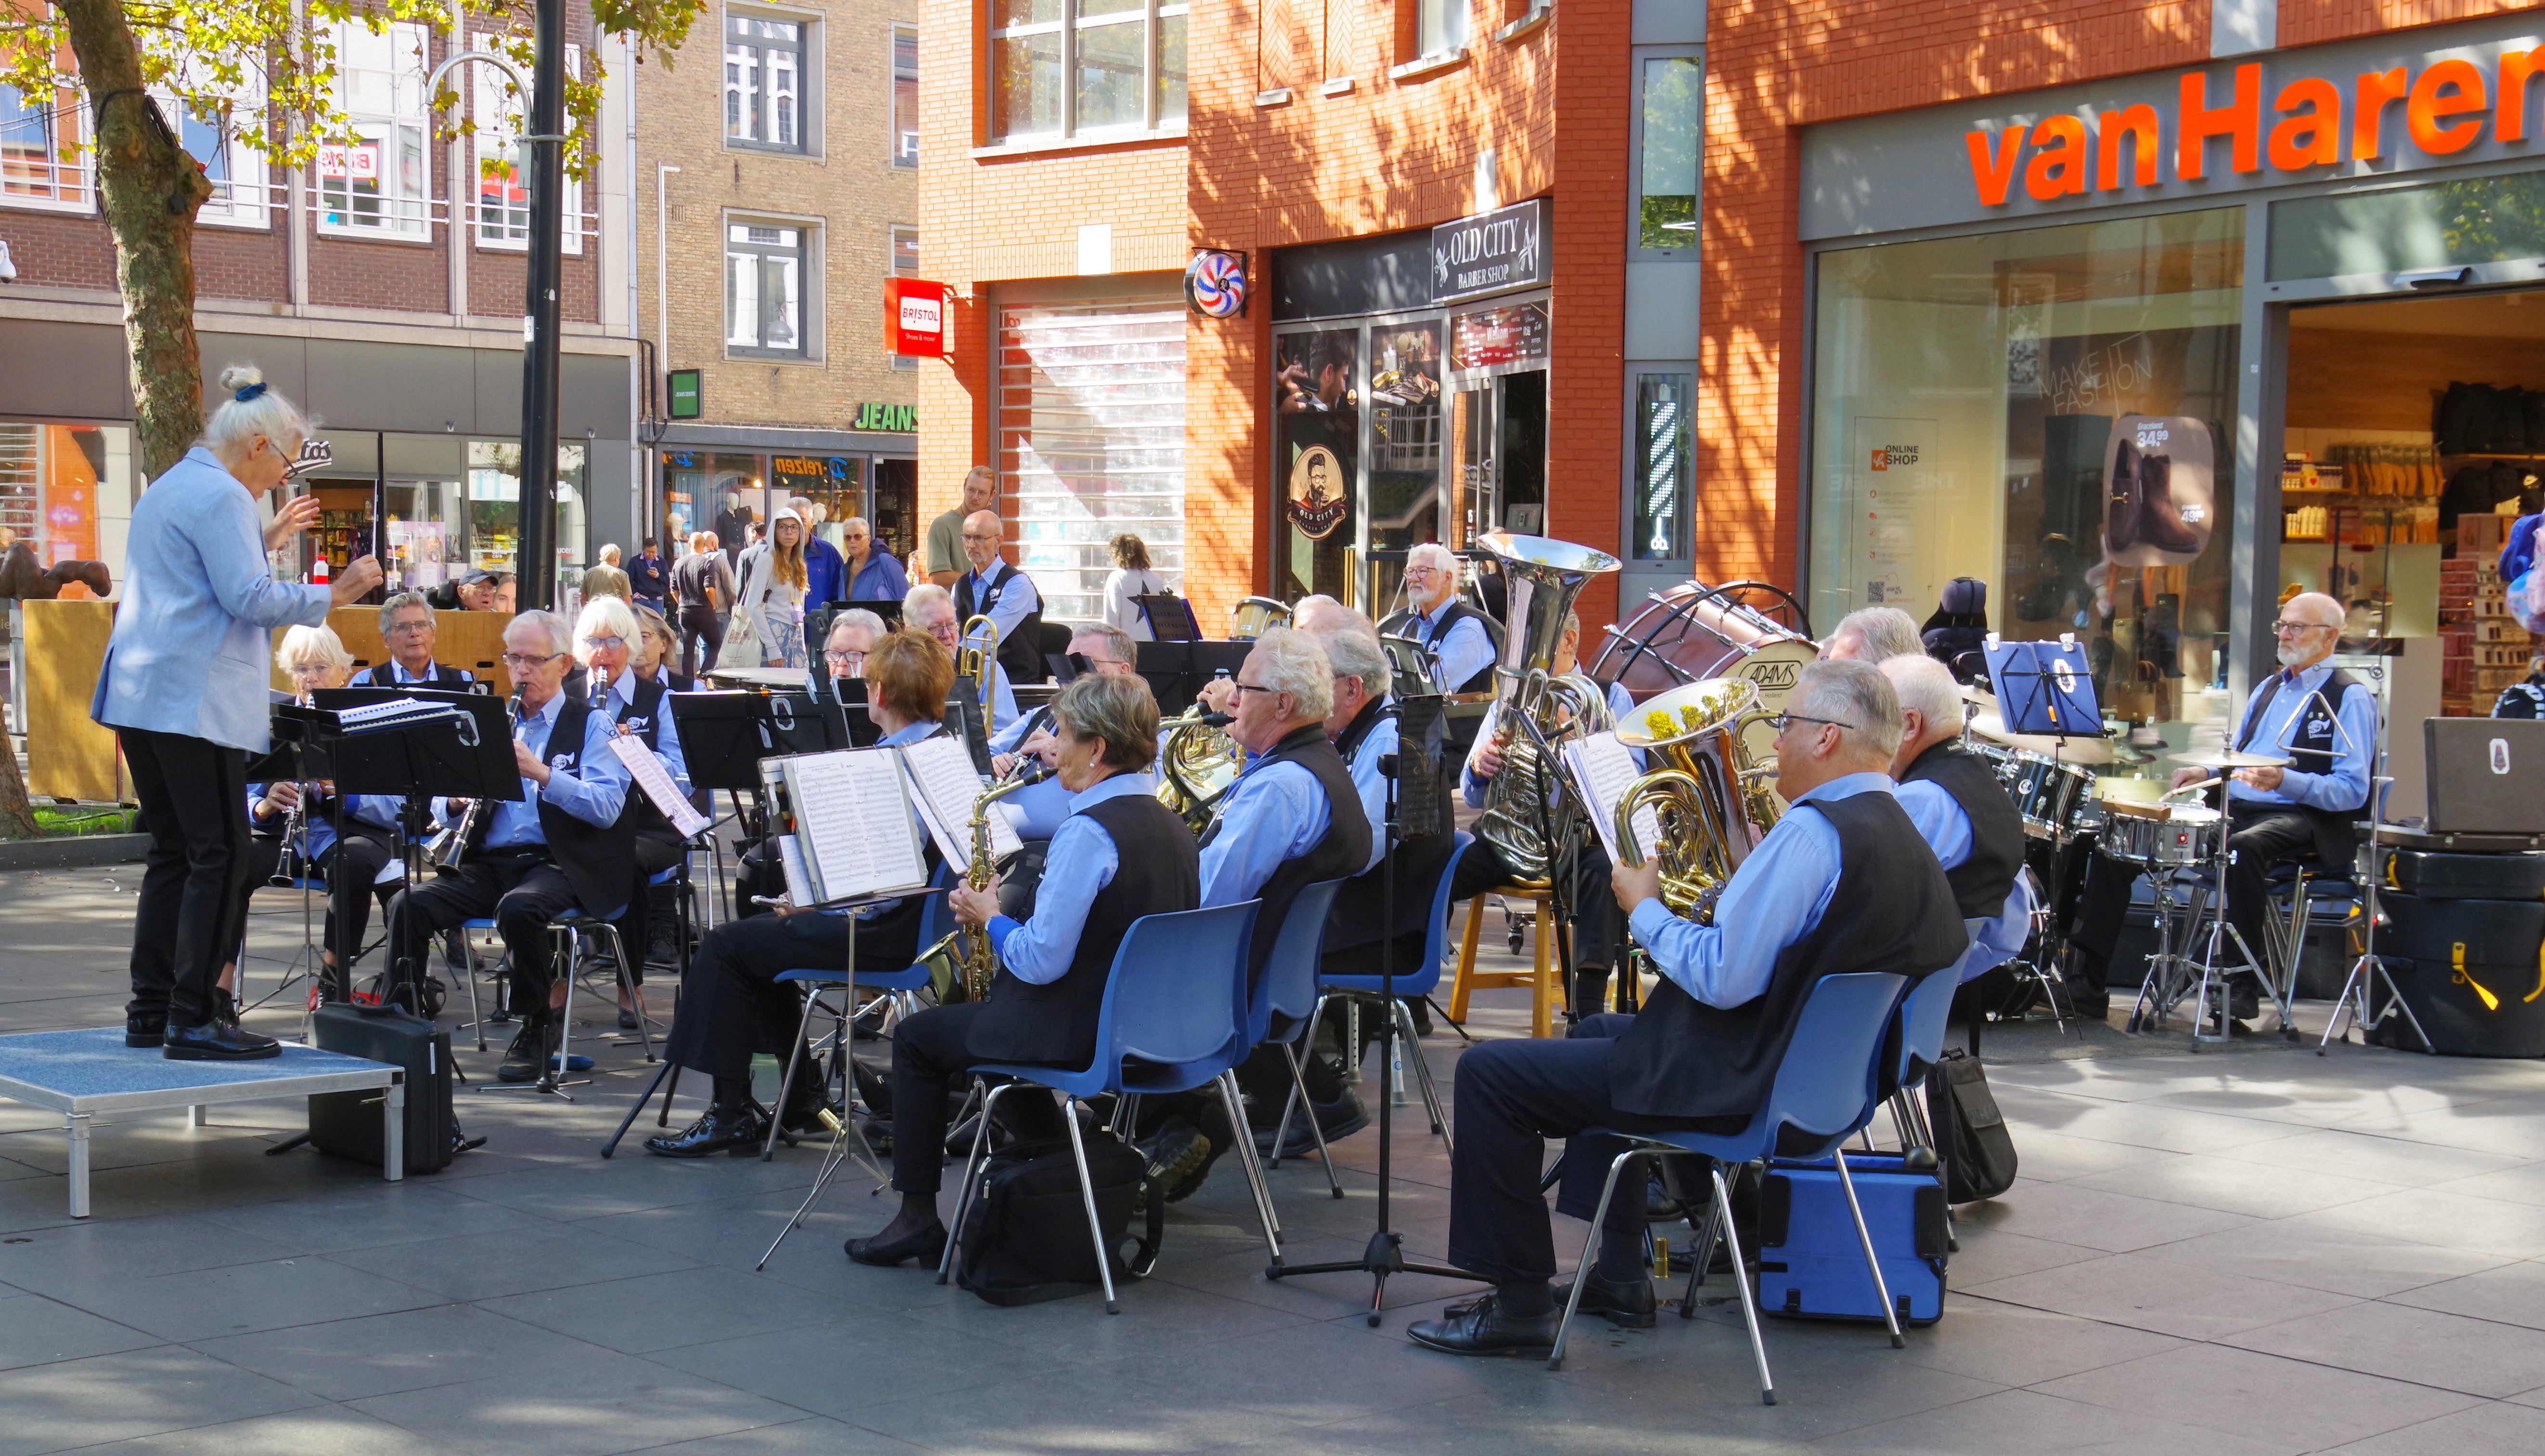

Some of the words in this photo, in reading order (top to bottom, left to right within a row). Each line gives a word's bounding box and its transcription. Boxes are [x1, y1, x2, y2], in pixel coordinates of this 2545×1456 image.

[1451, 227, 1481, 265] OLD
[1483, 217, 1519, 258] CITY
[1458, 270, 1487, 289] BARBER
[1487, 264, 1509, 283] SHOP
[1486, 326, 1509, 341] Welkom
[2038, 351, 2100, 400] MAKE
[2053, 354, 2152, 420] FASHION
[2137, 430, 2168, 447] 34.99
[300, 440, 332, 461] tos
[1886, 445, 1919, 453] ONLINE
[1887, 454, 1918, 465] SHOP
[1300, 509, 1313, 520] OLD
[1317, 507, 1333, 522] CITY
[1749, 664, 1795, 684] ADAMS
